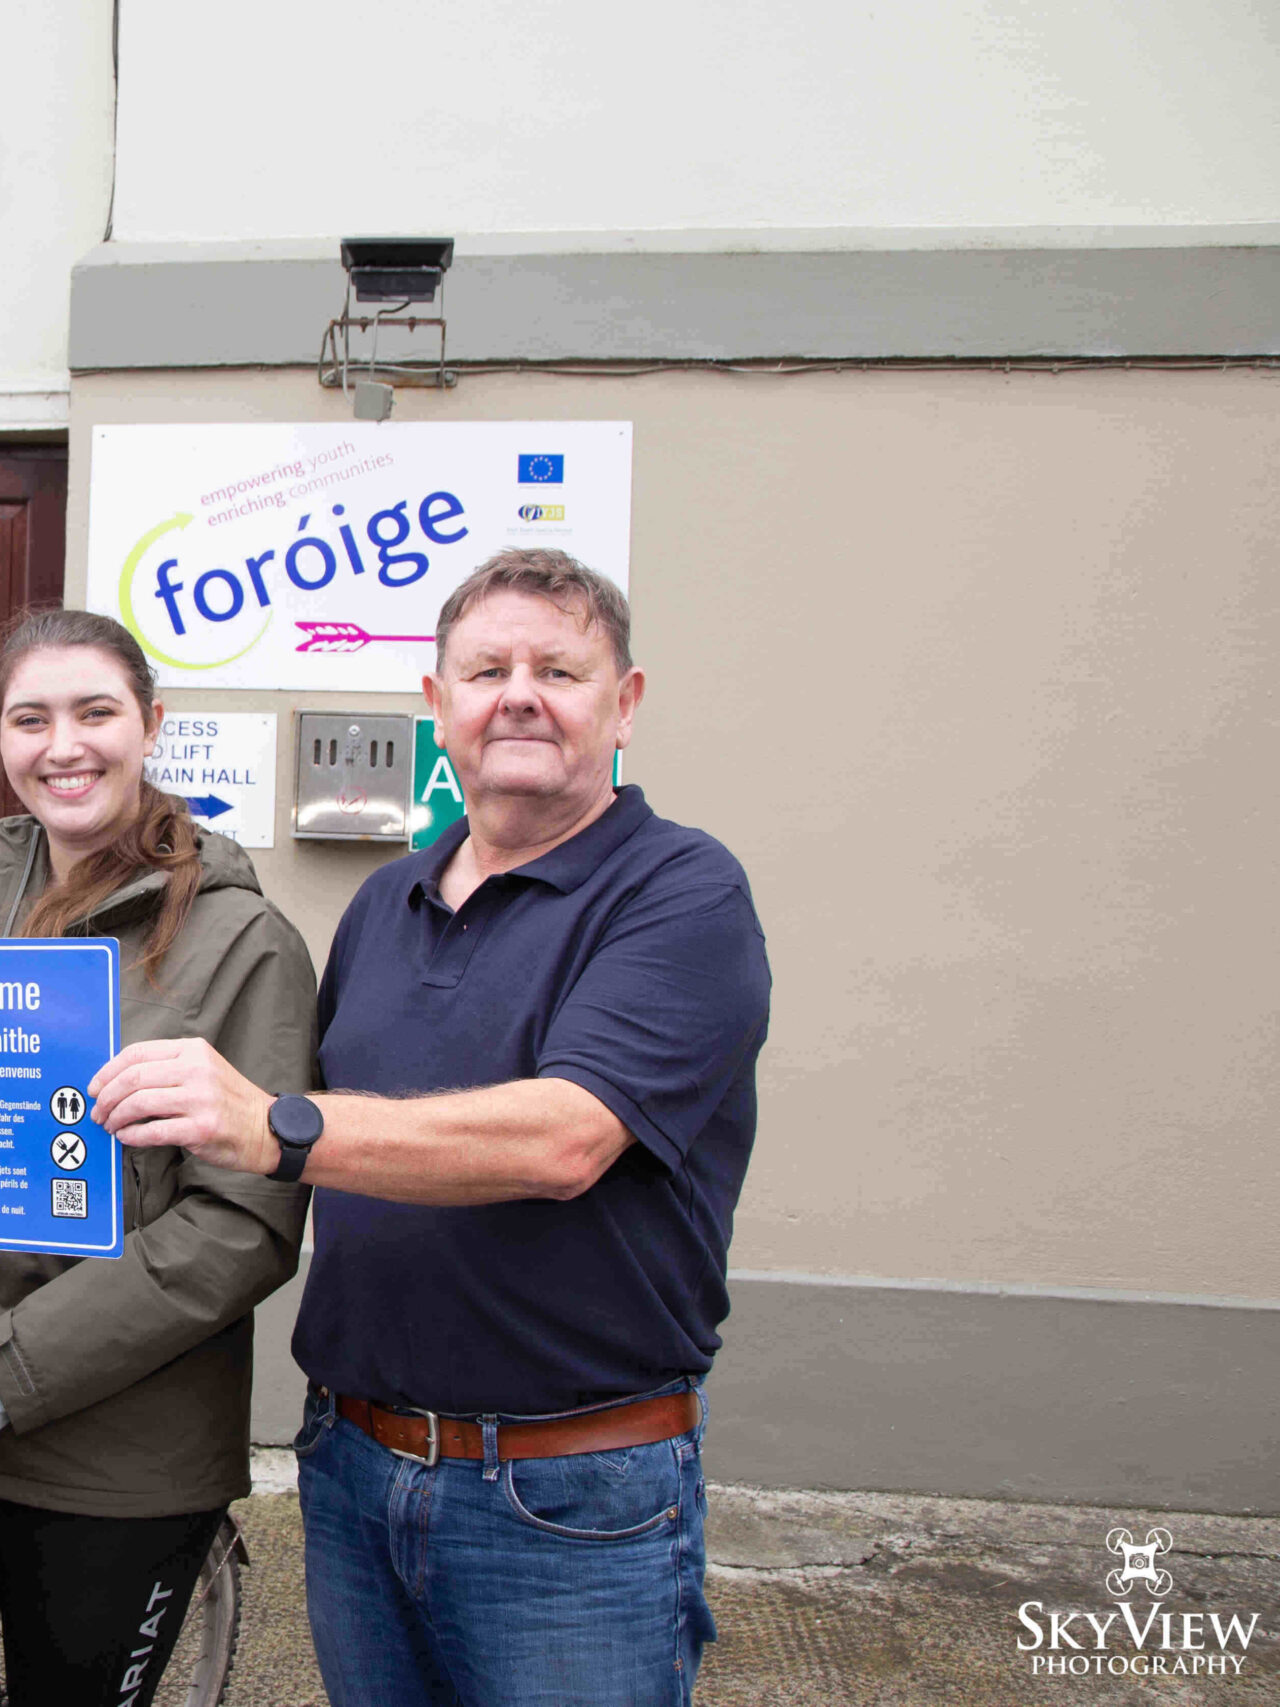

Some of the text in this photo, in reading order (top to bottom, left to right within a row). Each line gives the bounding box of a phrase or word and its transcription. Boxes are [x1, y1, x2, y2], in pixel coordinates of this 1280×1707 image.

[200, 440, 356, 506] empowering youth
[208, 452, 395, 526] enriching communities
[155, 490, 469, 635] foróige
[163, 721, 219, 737] CESS
[171, 744, 214, 760] LIFT
[144, 767, 257, 785] MAIN HALL
[0, 1100, 42, 1111] Gegenstände
[12, 1113, 25, 1123] des
[12, 1167, 27, 1176] sont
[0, 1178, 19, 1189] périls
[19, 1179, 29, 1189] de
[1, 1204, 10, 1214] de
[11, 1205, 26, 1215] nuit.
